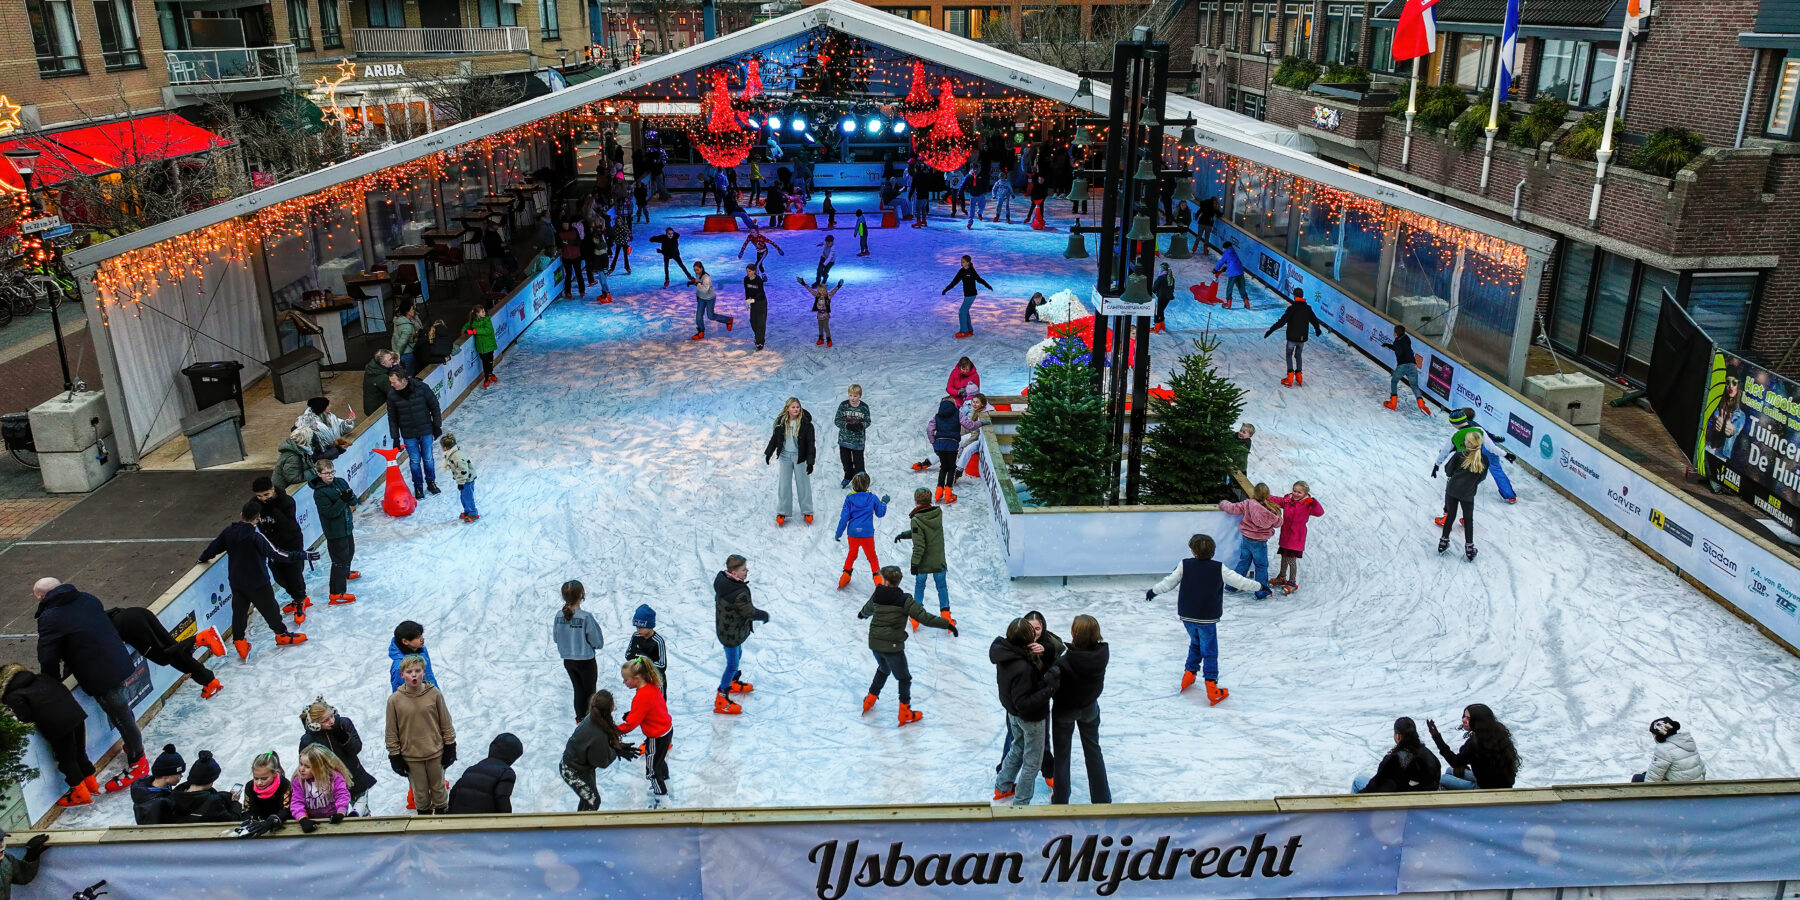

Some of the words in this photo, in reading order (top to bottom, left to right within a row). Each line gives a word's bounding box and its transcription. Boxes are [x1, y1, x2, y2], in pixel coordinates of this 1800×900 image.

[364, 63, 406, 78] ARIBA
[1744, 375, 1765, 399] Het
[1741, 390, 1764, 414] bestel
[1763, 405, 1788, 425] online
[1748, 442, 1769, 473] De
[1723, 467, 1742, 488] ZENA
[1607, 488, 1641, 516] KORVER
[1768, 494, 1782, 510] HIER
[1652, 511, 1663, 528] HL
[1702, 541, 1738, 572] Stadam
[1750, 566, 1762, 579] P.A.
[1763, 576, 1776, 587] van
[1753, 579, 1767, 592] TOP
[808, 839, 1025, 900] IJsbaan
[1040, 832, 1303, 897] Mijdrecht
